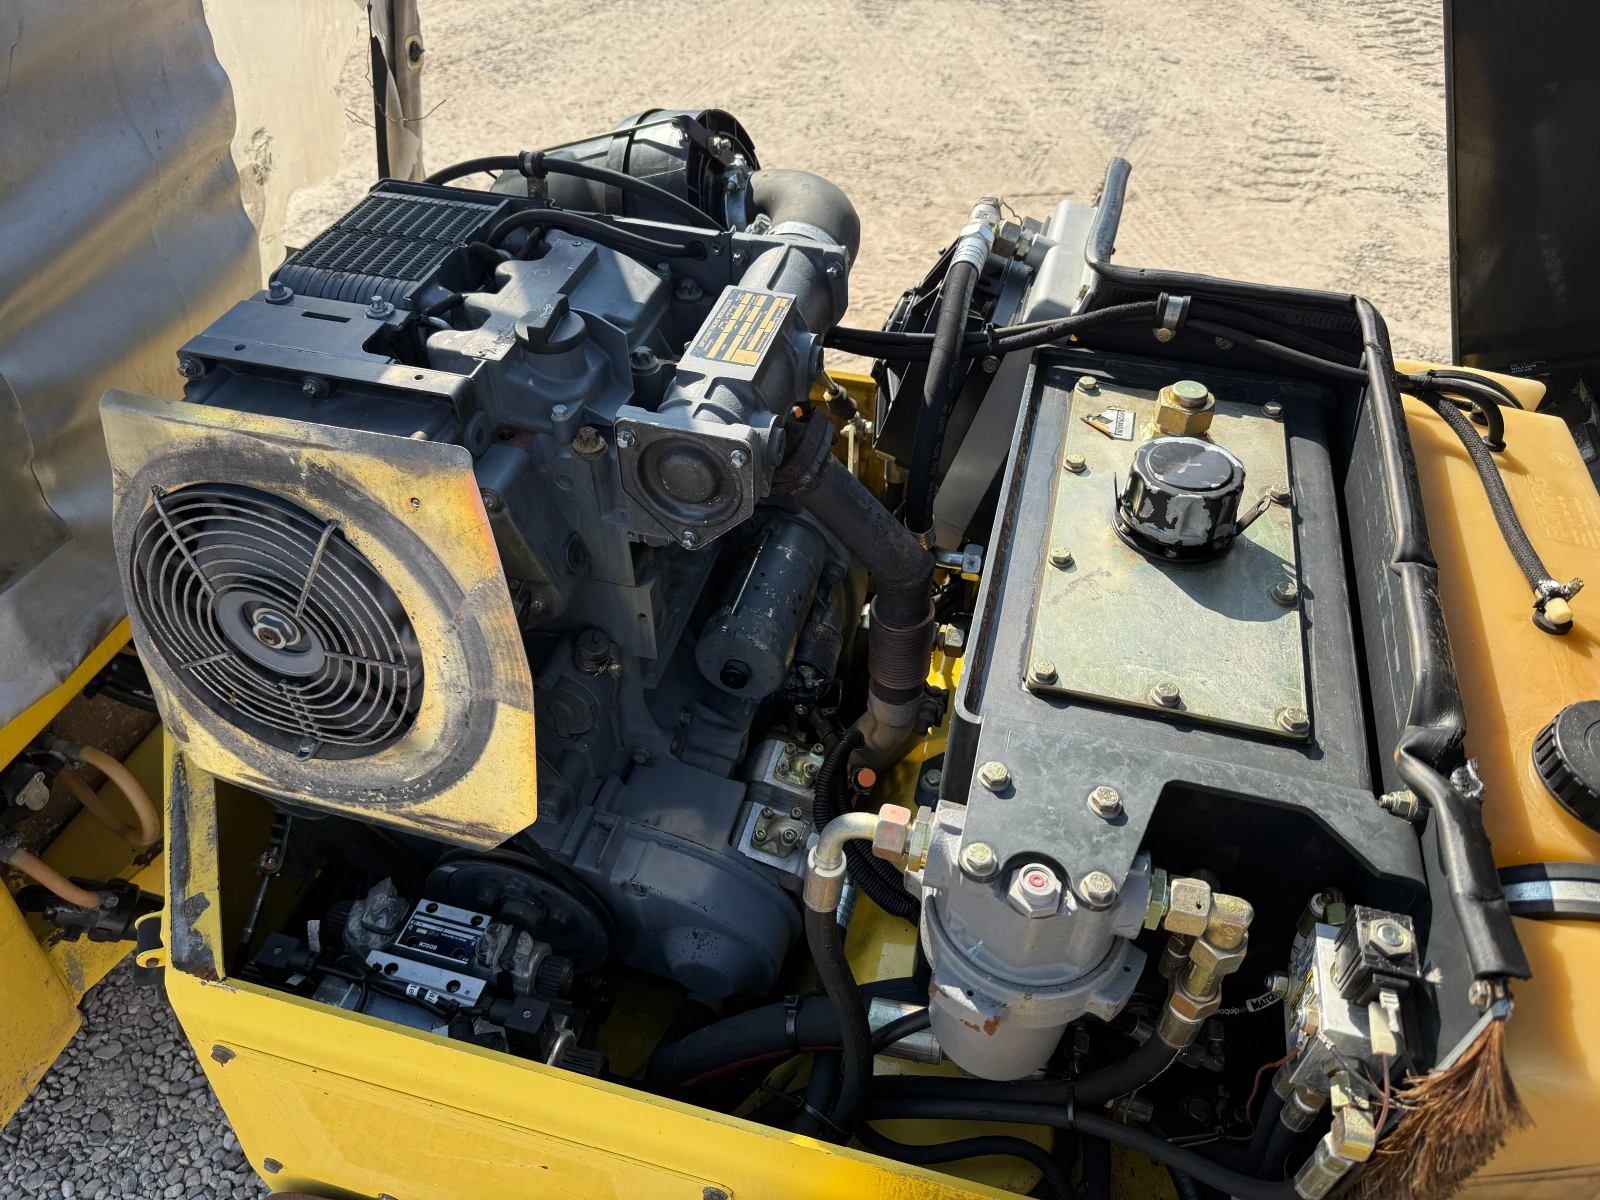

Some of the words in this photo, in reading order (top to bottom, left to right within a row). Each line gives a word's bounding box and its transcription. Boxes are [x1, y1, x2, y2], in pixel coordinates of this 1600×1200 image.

[937, 415, 946, 434] 3620
[1526, 473, 1571, 543] BOMAG
[419, 941, 437, 950] BOSCH
